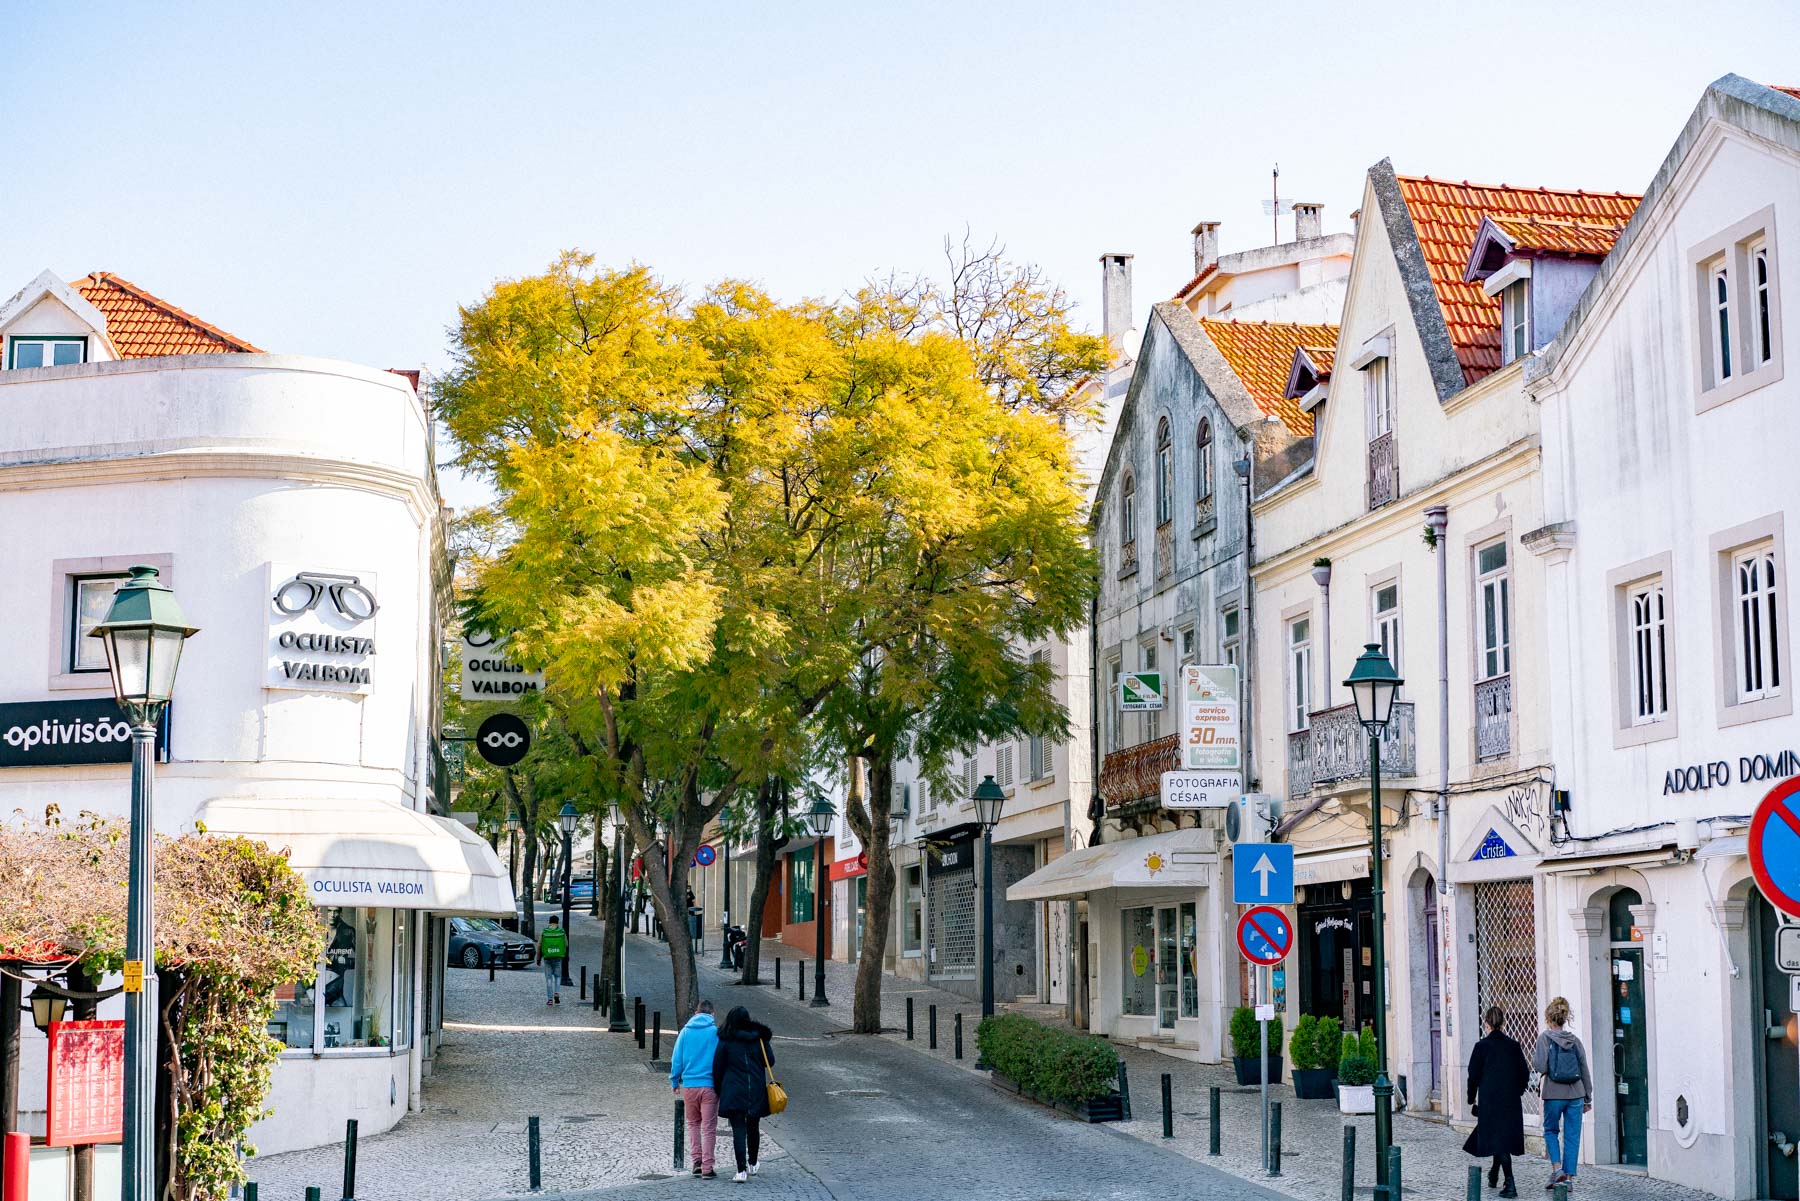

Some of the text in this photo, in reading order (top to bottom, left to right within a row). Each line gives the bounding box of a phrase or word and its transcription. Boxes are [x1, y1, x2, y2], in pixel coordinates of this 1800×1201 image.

[279, 630, 377, 655] OCULISTA
[283, 661, 371, 685] VALBOM
[468, 659, 542, 673] OCULIS
[471, 680, 537, 694] VALBOM
[1195, 714, 1230, 722] expresso
[1188, 727, 1238, 745] 30 min.
[1169, 778, 1240, 788] FOTOGRAFIA
[1663, 760, 1730, 796] ADOLFO
[1170, 790, 1208, 802] CÉSAR
[1480, 841, 1506, 859] Cristal
[313, 880, 424, 895] OCULISTA VALBOM
[326, 947, 353, 955] LAURENT
